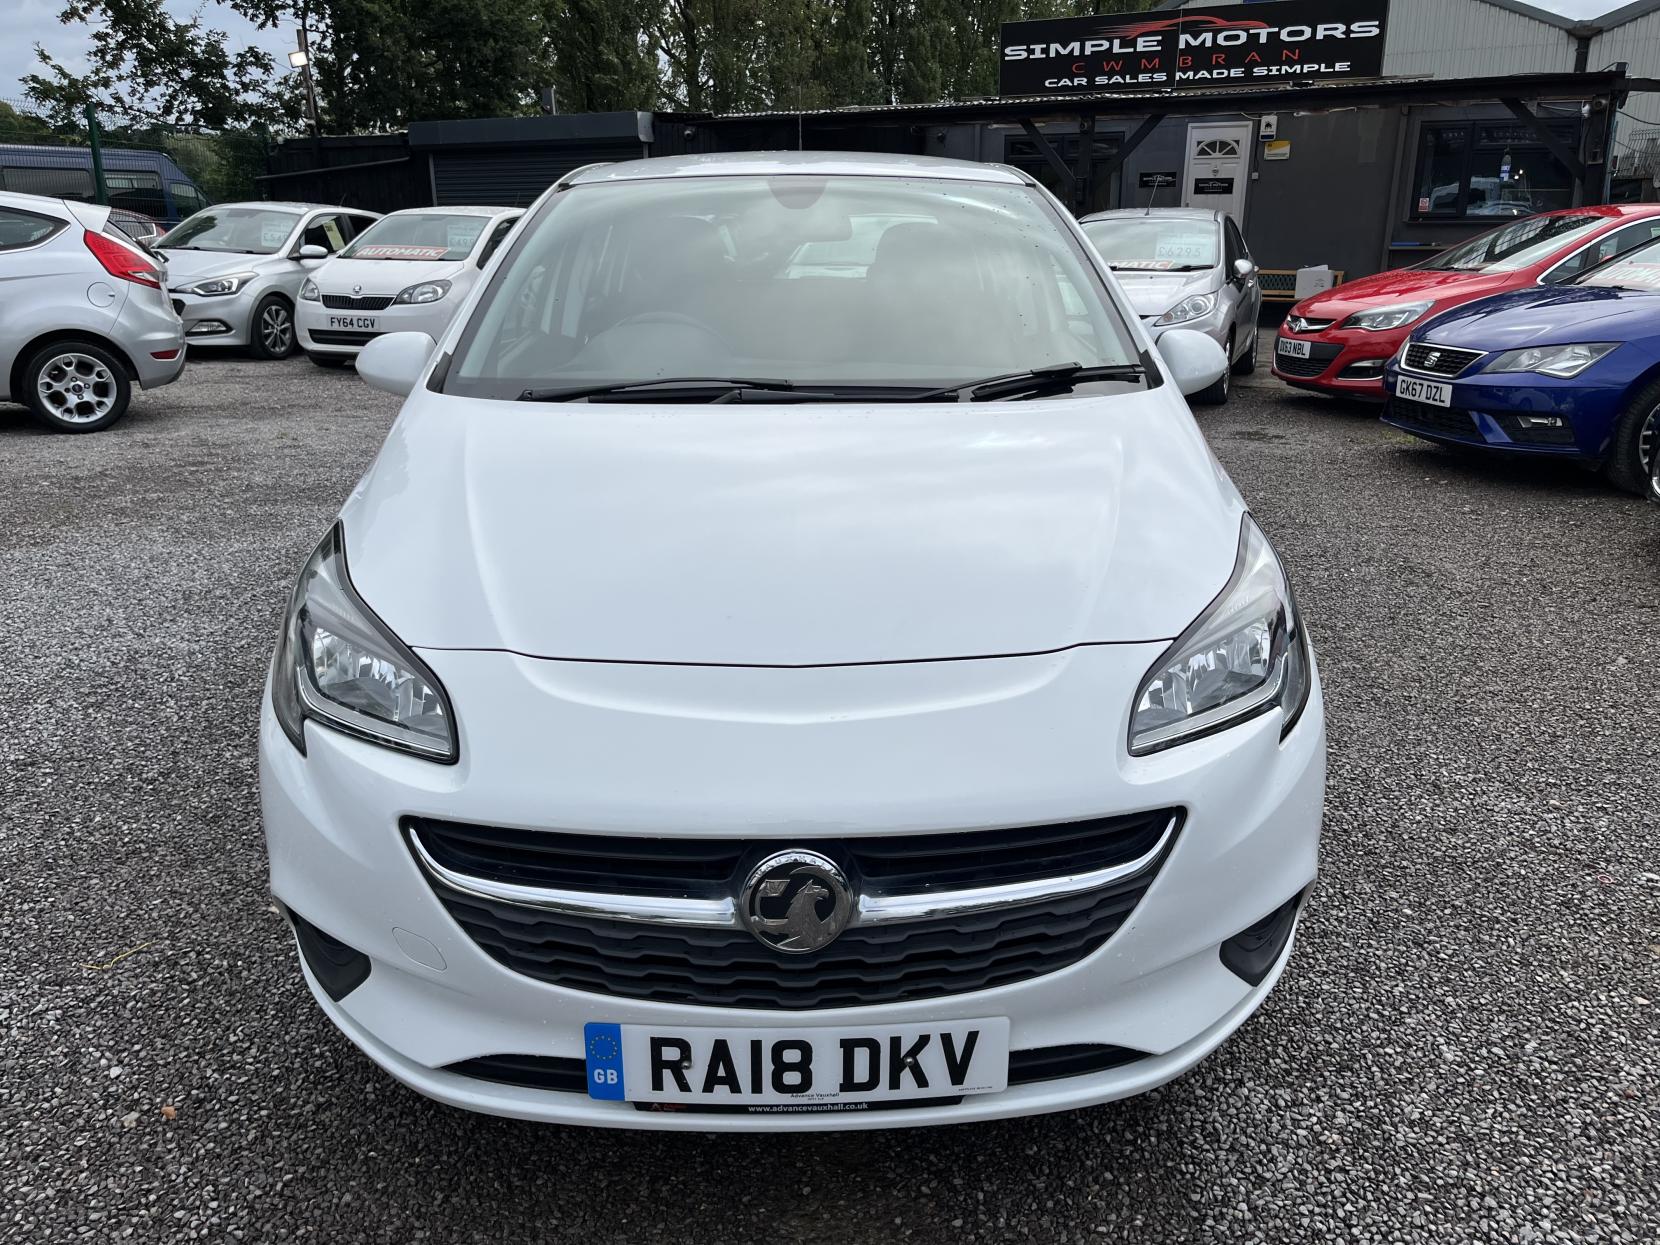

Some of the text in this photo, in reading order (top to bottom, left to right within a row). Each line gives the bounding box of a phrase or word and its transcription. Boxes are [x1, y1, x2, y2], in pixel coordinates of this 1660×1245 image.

[1004, 20, 1381, 61] SIMPLE MOTORS
[1072, 48, 1301, 74] CWMBRAN
[1045, 61, 1353, 88] CAR SALES MADE SIMPLE
[357, 247, 443, 257] AUTOMATIC
[1158, 246, 1201, 258] £6295
[330, 316, 376, 329] FY64 CGV
[1291, 341, 1306, 356] NBL
[1399, 379, 1446, 404] GK67 DZL
[650, 1031, 980, 1094] RA18 DKV
[593, 1068, 619, 1085] GB
[748, 1102, 869, 1114] www.advancevauxhall.co.uk
